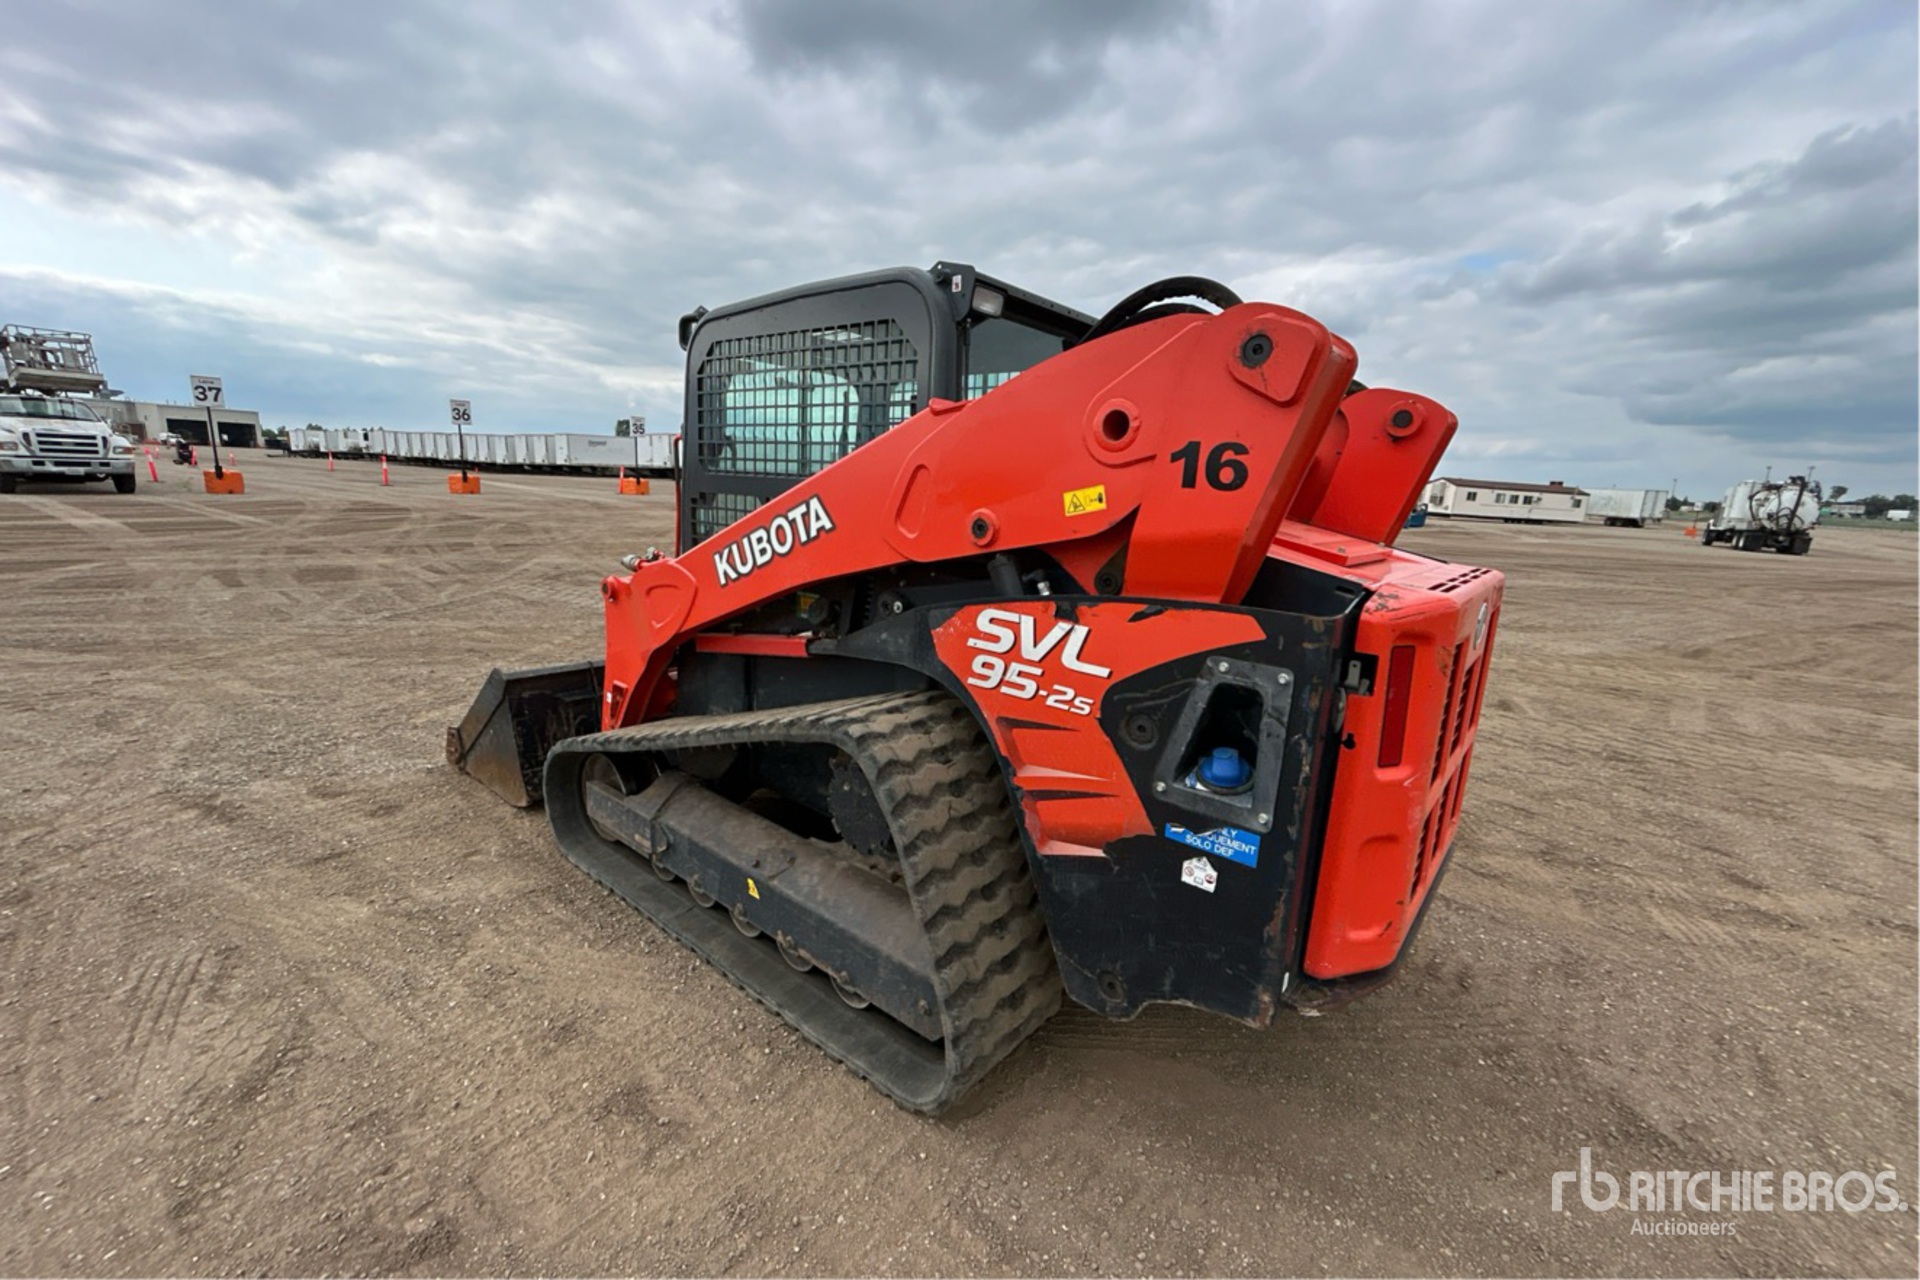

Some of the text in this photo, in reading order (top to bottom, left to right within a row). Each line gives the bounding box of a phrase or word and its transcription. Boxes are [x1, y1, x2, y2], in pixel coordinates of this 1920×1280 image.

[194, 385, 221, 402] 37
[452, 407, 470, 421] 36
[632, 422, 645, 435] 35
[1170, 440, 1249, 492] 16
[713, 495, 835, 587] KUBOTA
[966, 608, 1111, 679] SVL
[1185, 833, 1235, 857] SOLO DEF
